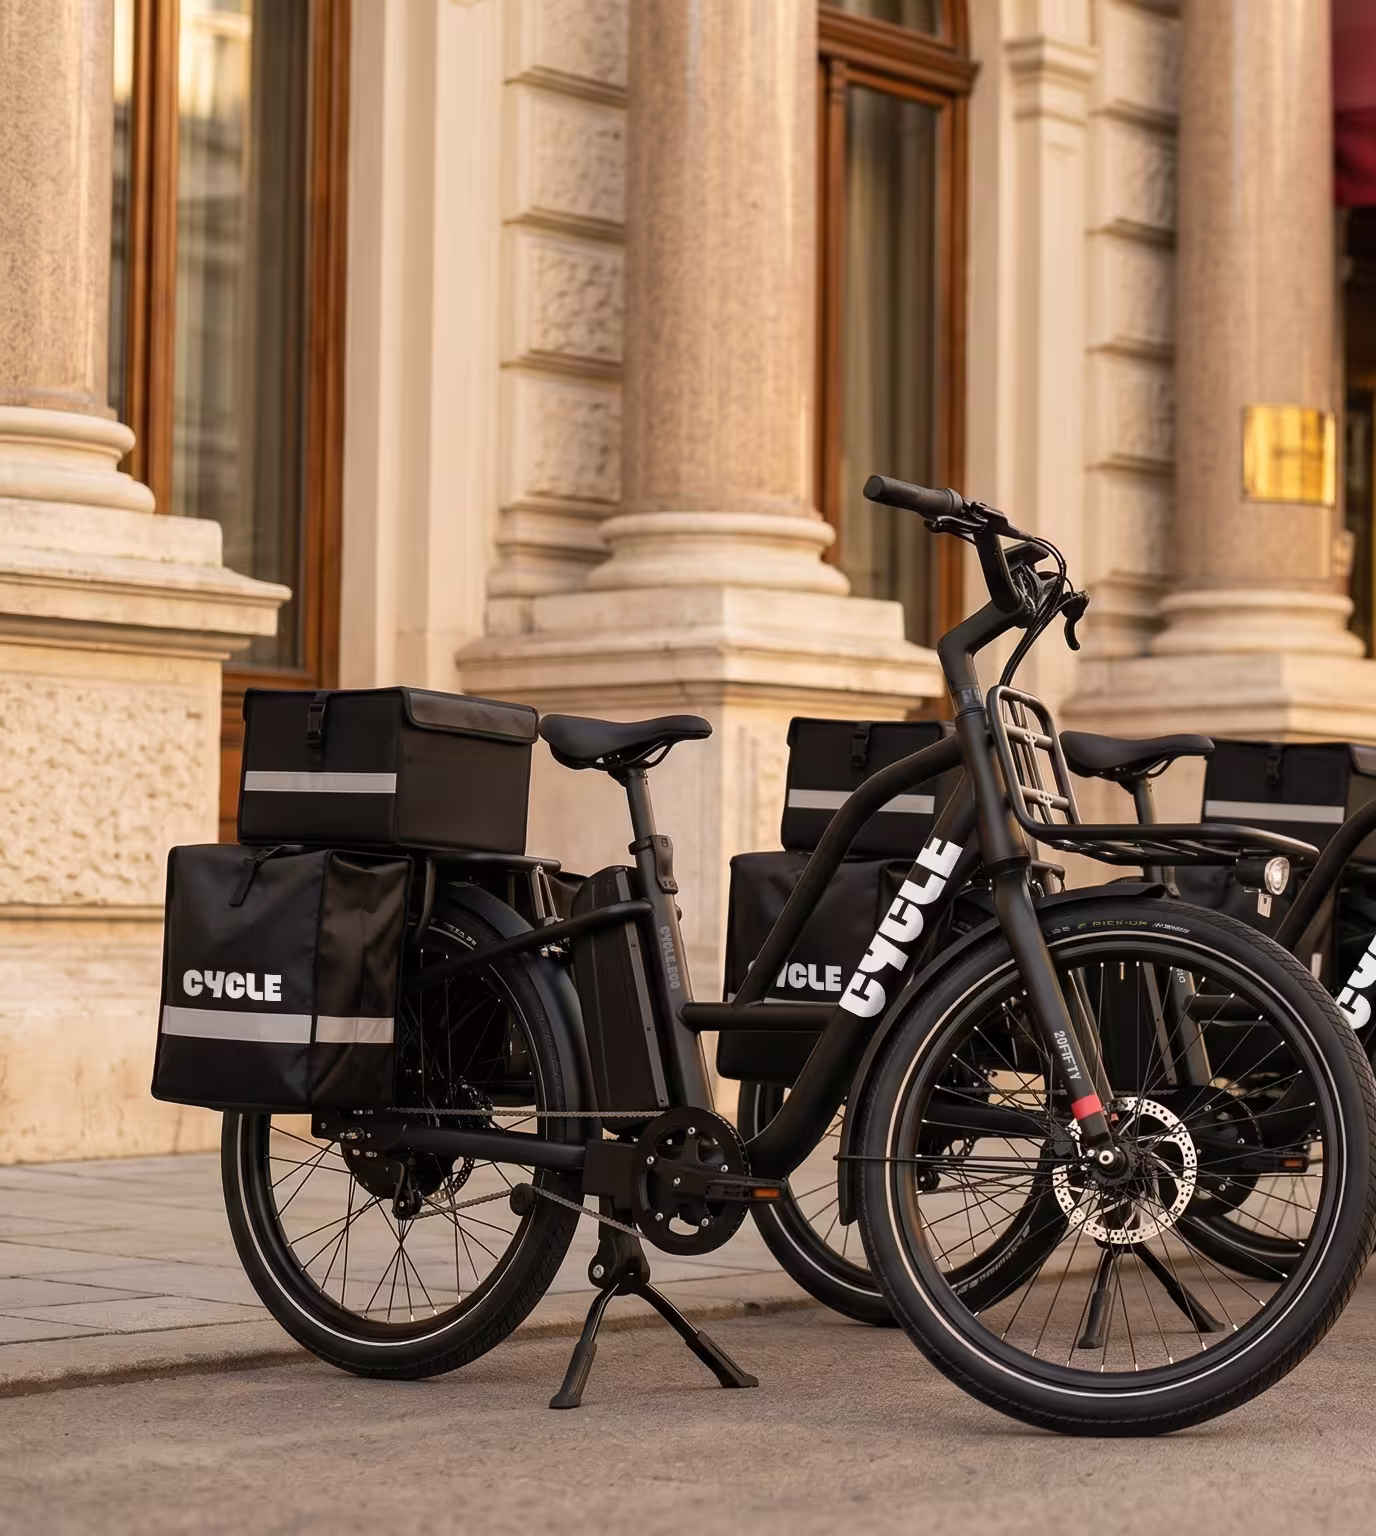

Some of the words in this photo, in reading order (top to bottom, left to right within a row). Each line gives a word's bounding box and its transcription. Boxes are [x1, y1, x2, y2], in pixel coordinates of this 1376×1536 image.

[839, 837, 963, 1018] CYCLE
[183, 969, 282, 1002] CYCLE
[1053, 1030, 1081, 1080] 20FIFTY
